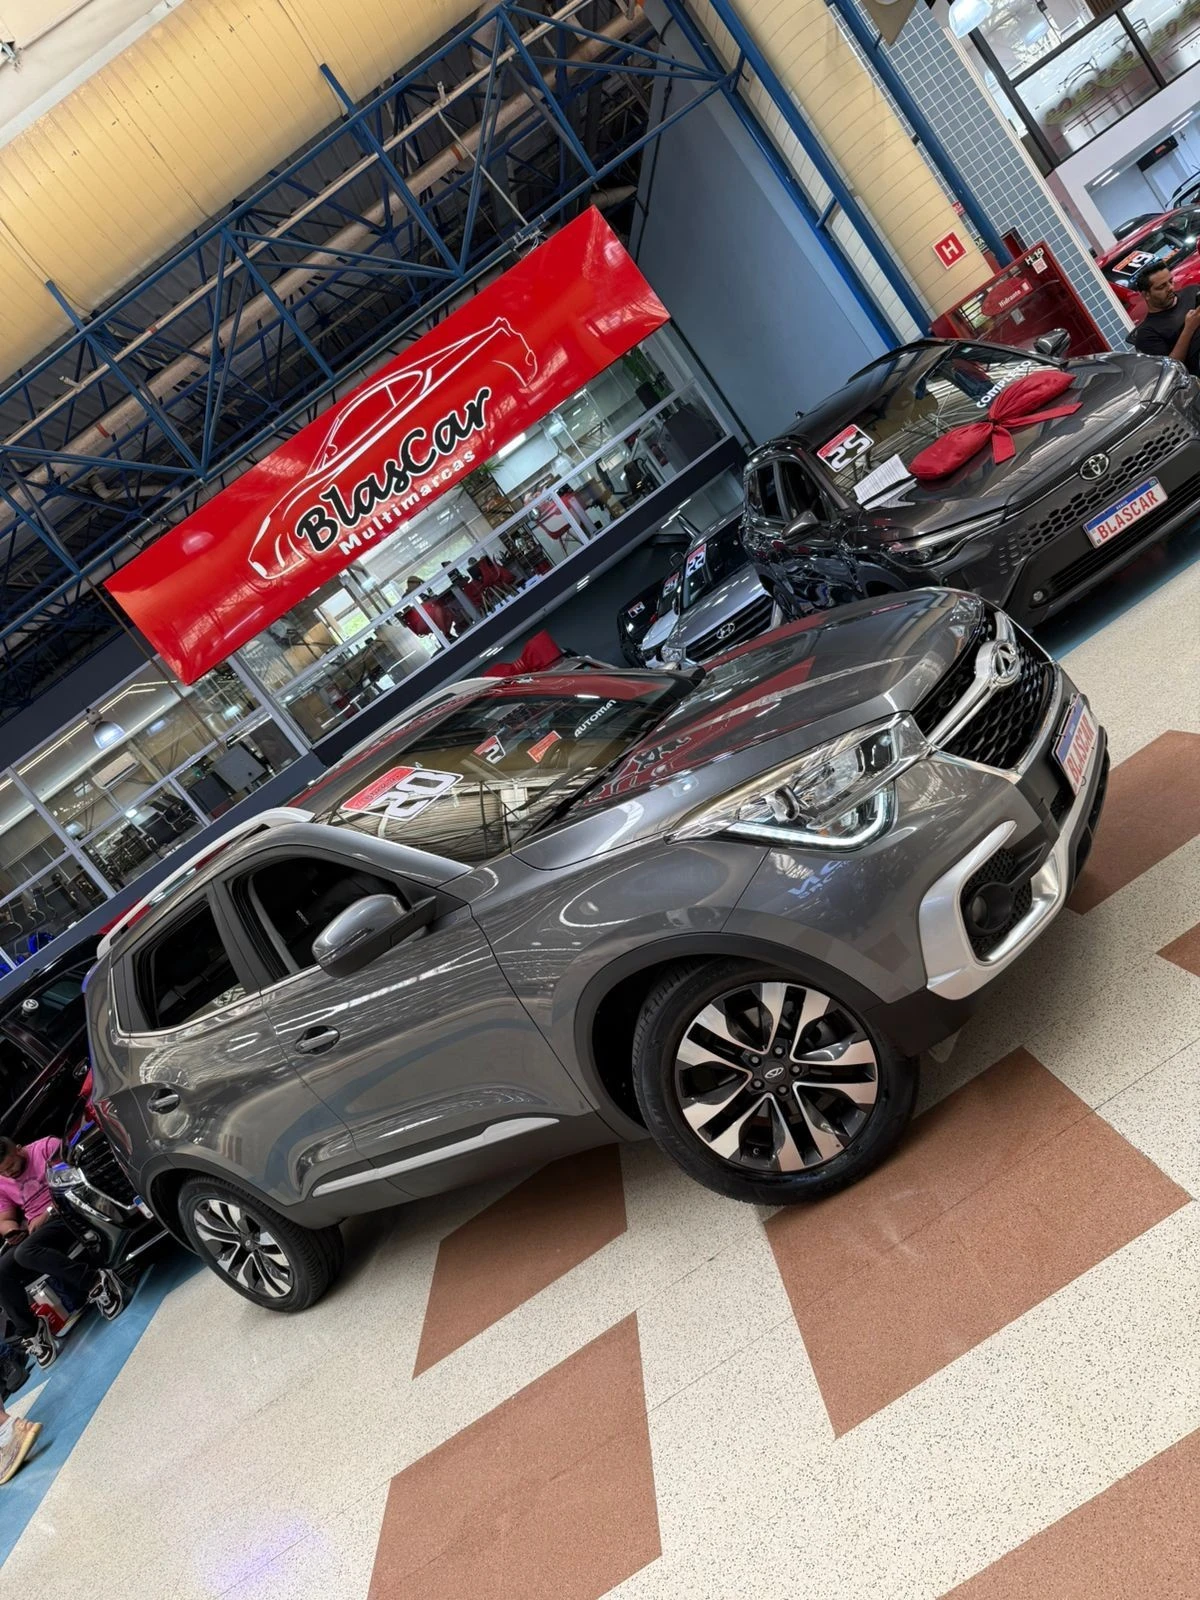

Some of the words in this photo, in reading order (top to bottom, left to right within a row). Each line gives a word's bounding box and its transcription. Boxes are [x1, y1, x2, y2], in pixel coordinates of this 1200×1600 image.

[941, 239, 959, 260] H
[295, 387, 492, 553] BlasCar
[826, 432, 871, 469] 25
[339, 450, 476, 555] Multimarcas
[1096, 490, 1159, 539] BLASCAR
[1066, 713, 1095, 784] BLASCAR
[372, 770, 451, 818] 20
